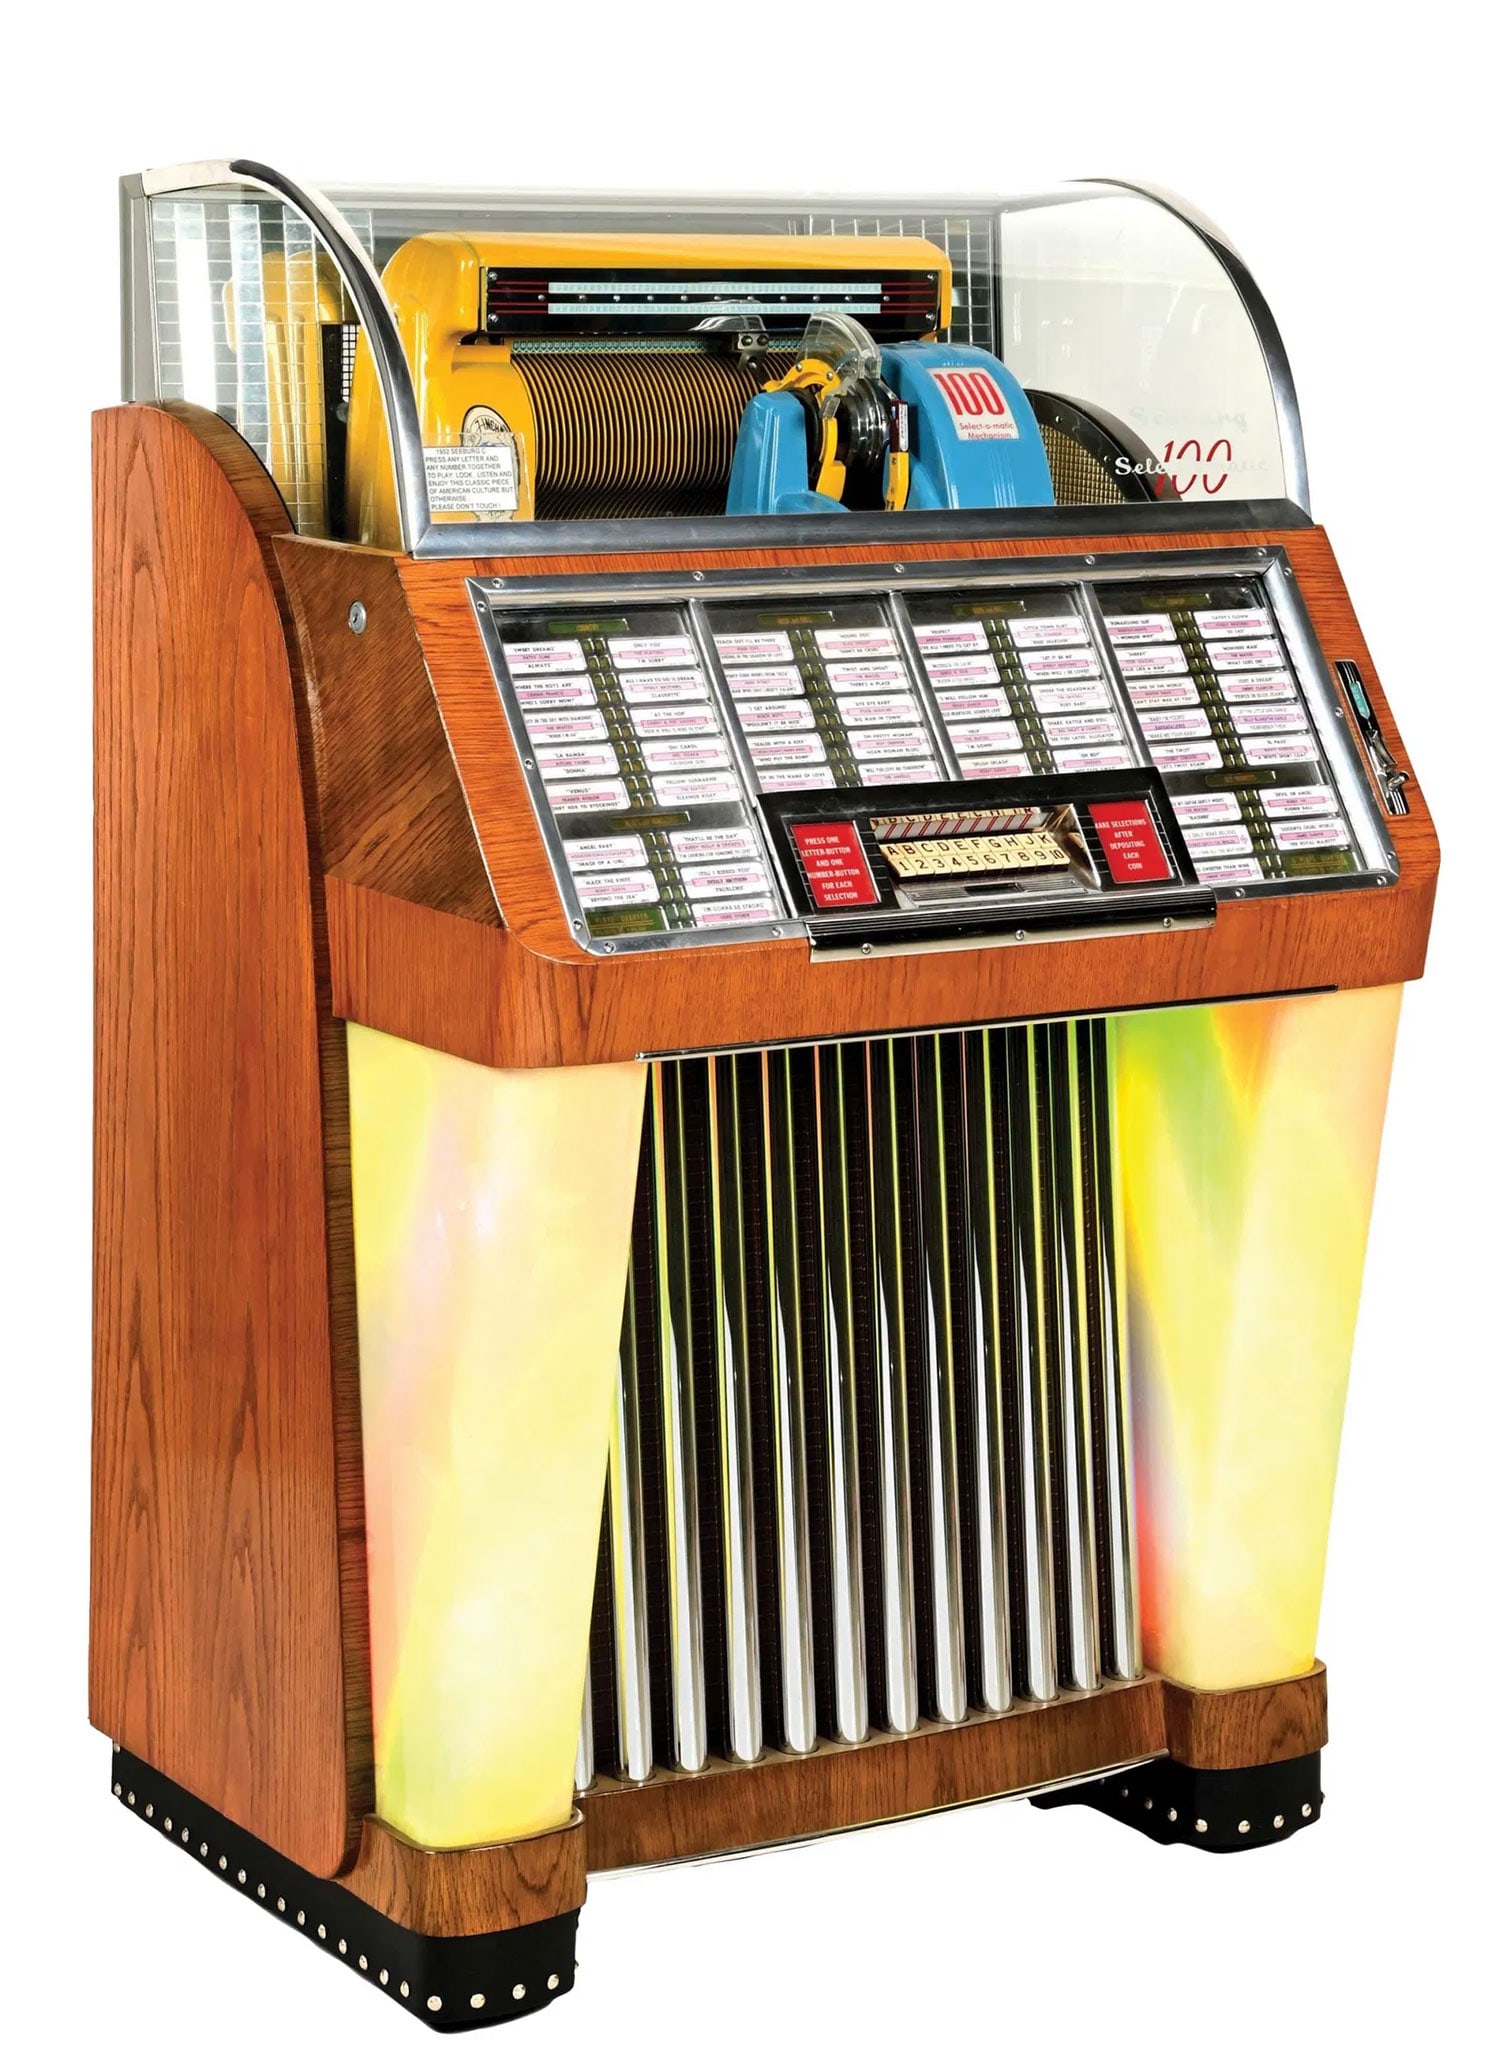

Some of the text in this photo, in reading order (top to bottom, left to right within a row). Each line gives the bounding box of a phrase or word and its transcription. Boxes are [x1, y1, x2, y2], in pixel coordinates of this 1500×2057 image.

[933, 373, 1005, 415] 100
[1154, 439, 1232, 497] 100
[1111, 819, 1146, 827] SELECTIONS
[805, 837, 825, 845] PRESS
[887, 834, 1053, 855] A B C D E F G H J K
[1109, 841, 1145, 850] DEPOSITING
[801, 847, 851, 857] LETTER-BUTTON
[899, 849, 1064, 871] 1 2 3 4 5 6 7 8 9 10
[807, 869, 860, 879] NUMBER-BUTTON
[824, 892, 858, 901] SELECTION
